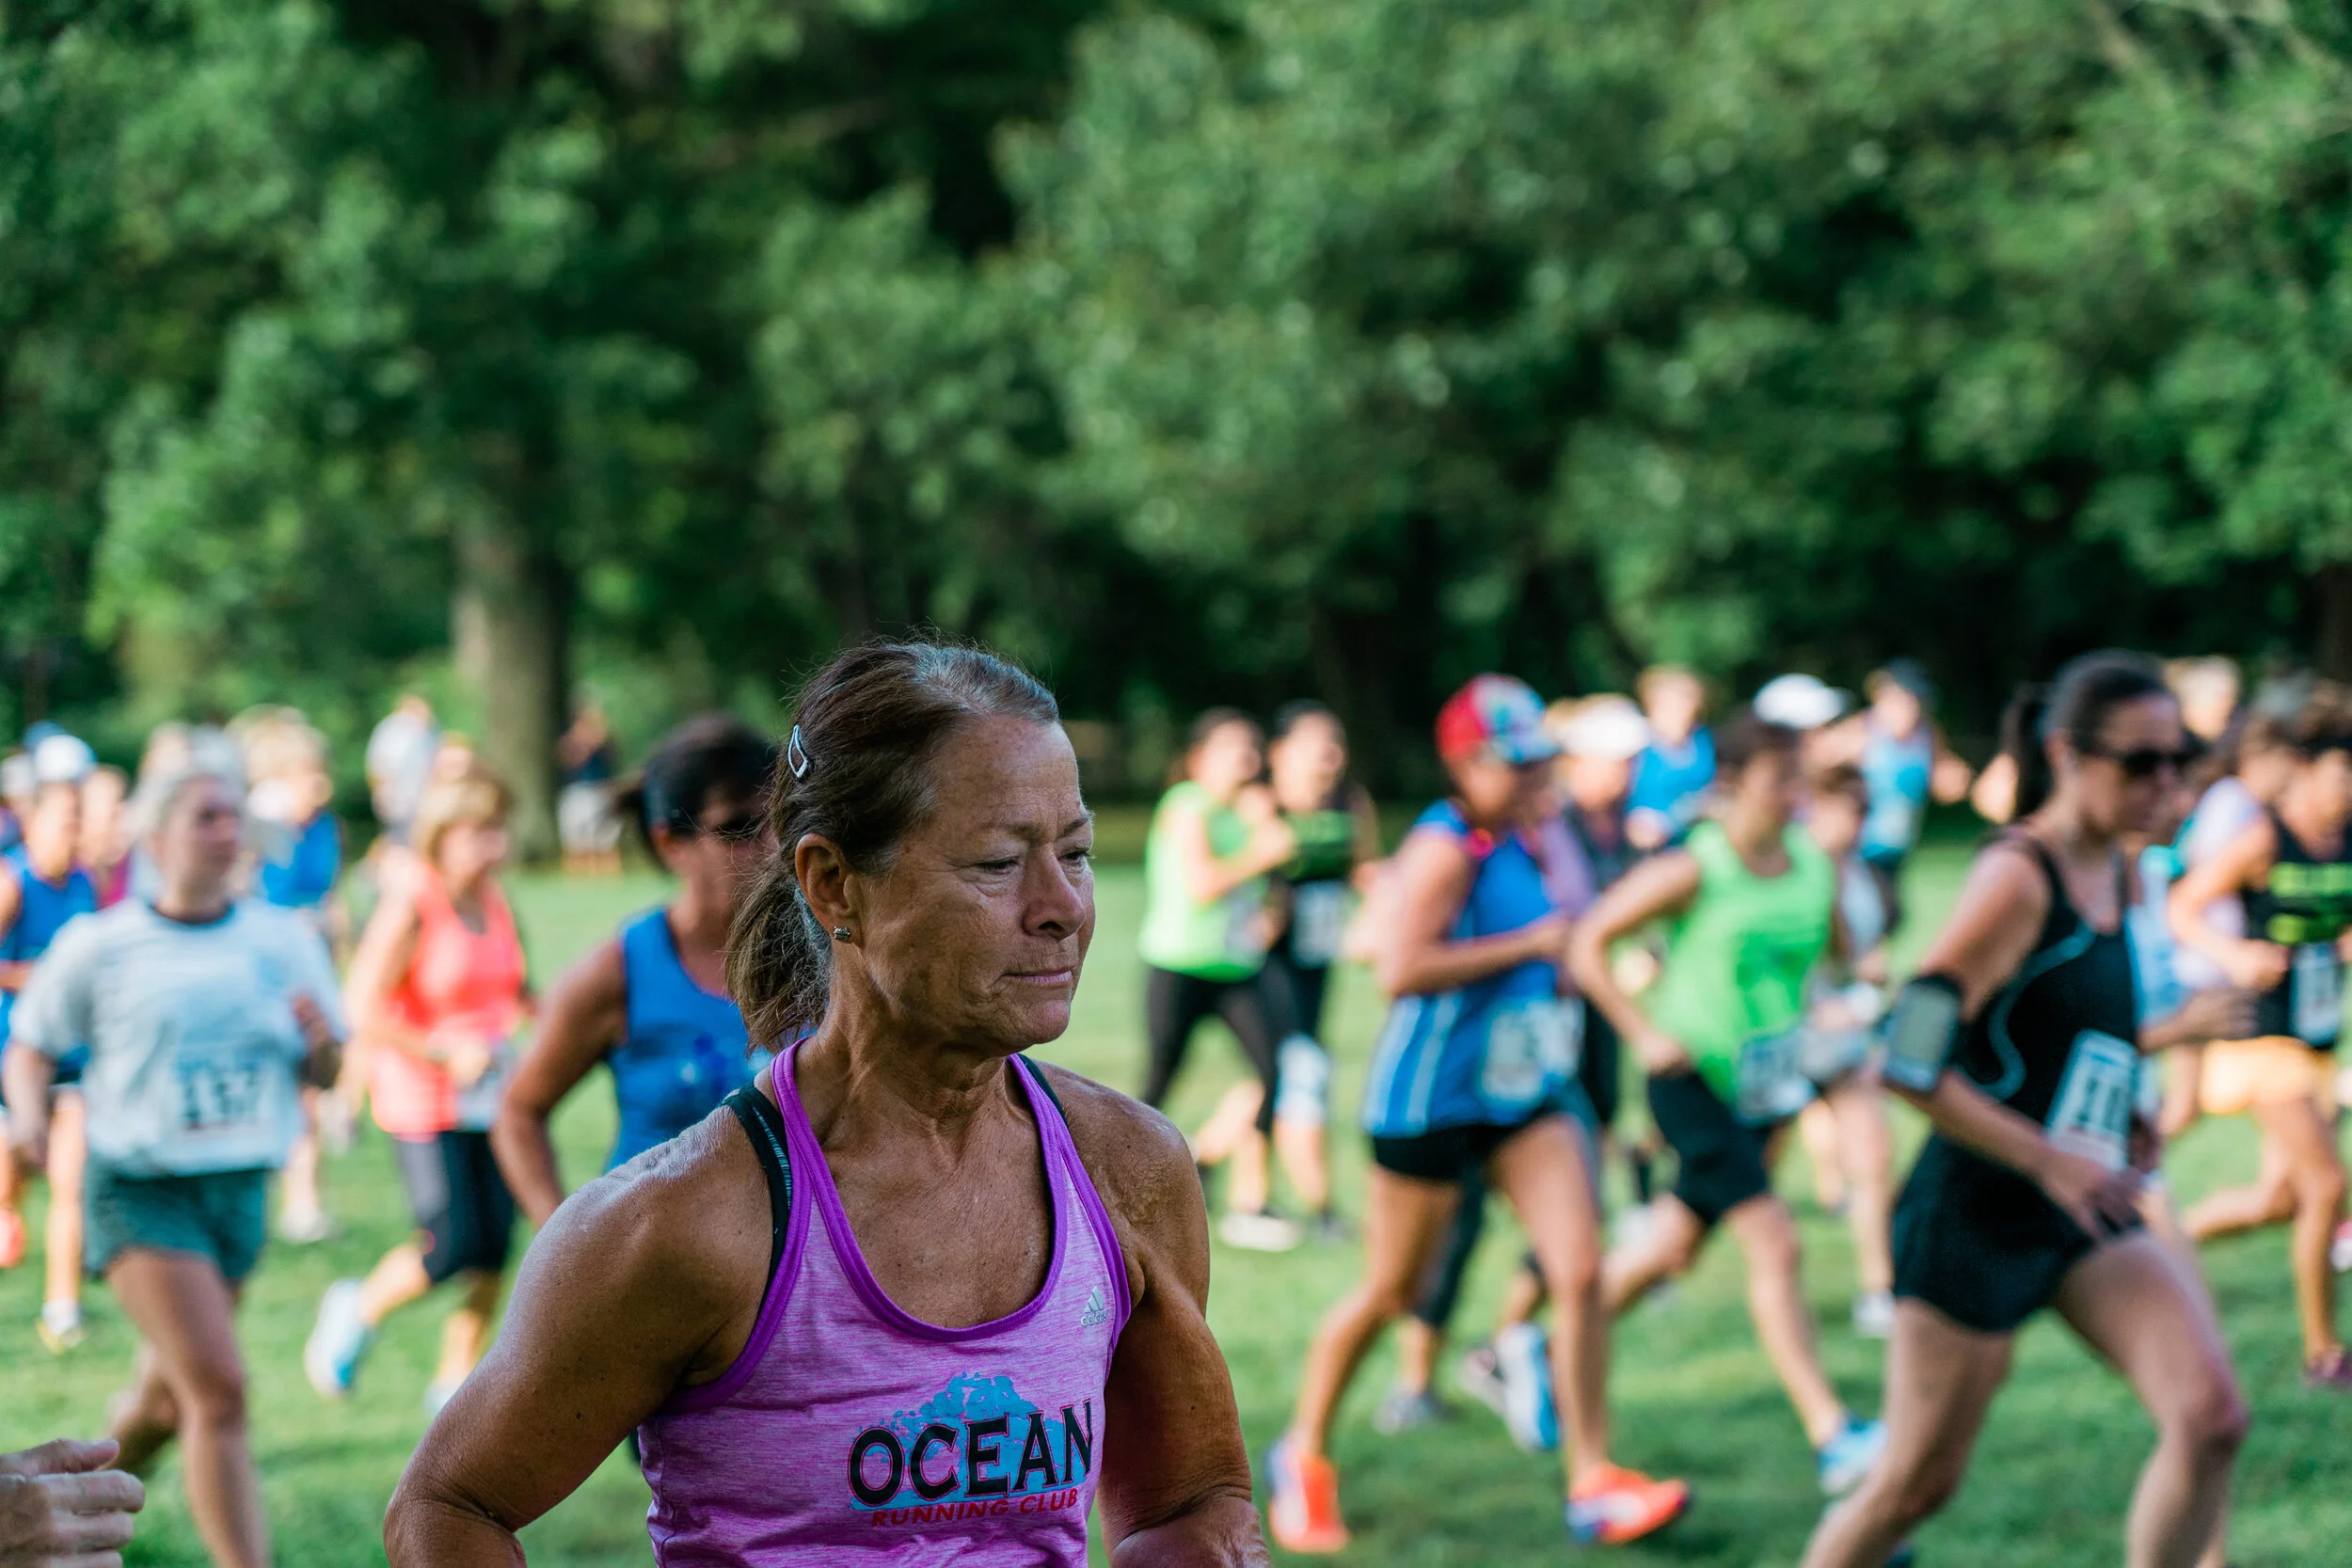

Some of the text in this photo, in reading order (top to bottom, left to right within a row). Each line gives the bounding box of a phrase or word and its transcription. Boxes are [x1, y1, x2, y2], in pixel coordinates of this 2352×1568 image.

[849, 1398, 1092, 1507] OCEAN
[871, 1488, 1078, 1527] RUNNING CLUB
